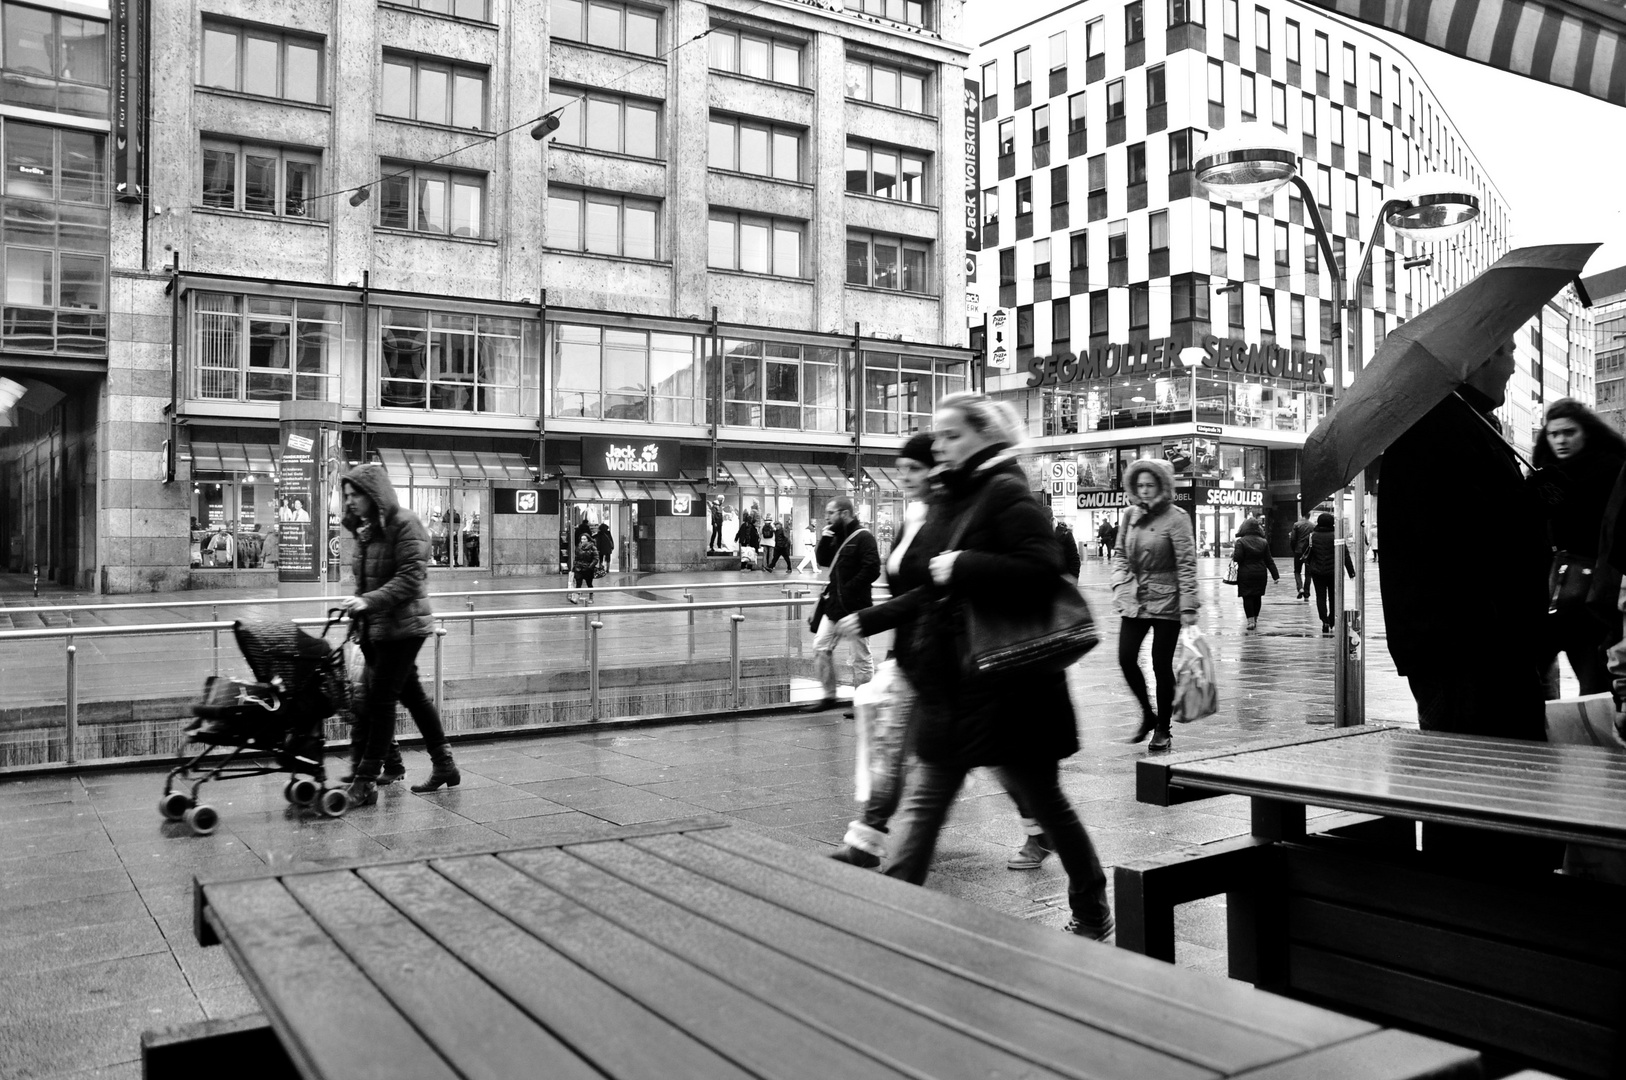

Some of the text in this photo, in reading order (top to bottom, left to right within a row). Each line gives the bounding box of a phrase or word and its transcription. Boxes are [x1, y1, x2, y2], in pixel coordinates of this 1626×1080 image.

[119, 24, 127, 63] guten
[965, 116, 976, 239] Jack Wolfskin
[966, 293, 979, 303] ack
[966, 304, 979, 312] ERK
[992, 317, 1006, 325] Pizza
[993, 353, 1007, 361] Pizza
[1026, 336, 1184, 388] SEGMÜLLER
[1200, 335, 1327, 384] SEGMÜLLER
[605, 444, 637, 458] Jack
[605, 457, 659, 472] Wolfskin
[1054, 482, 1062, 493] U
[1077, 492, 1132, 508] GMÜLLER
[1173, 493, 1192, 501] BEL
[1206, 489, 1263, 506] SEGMÜLLER
